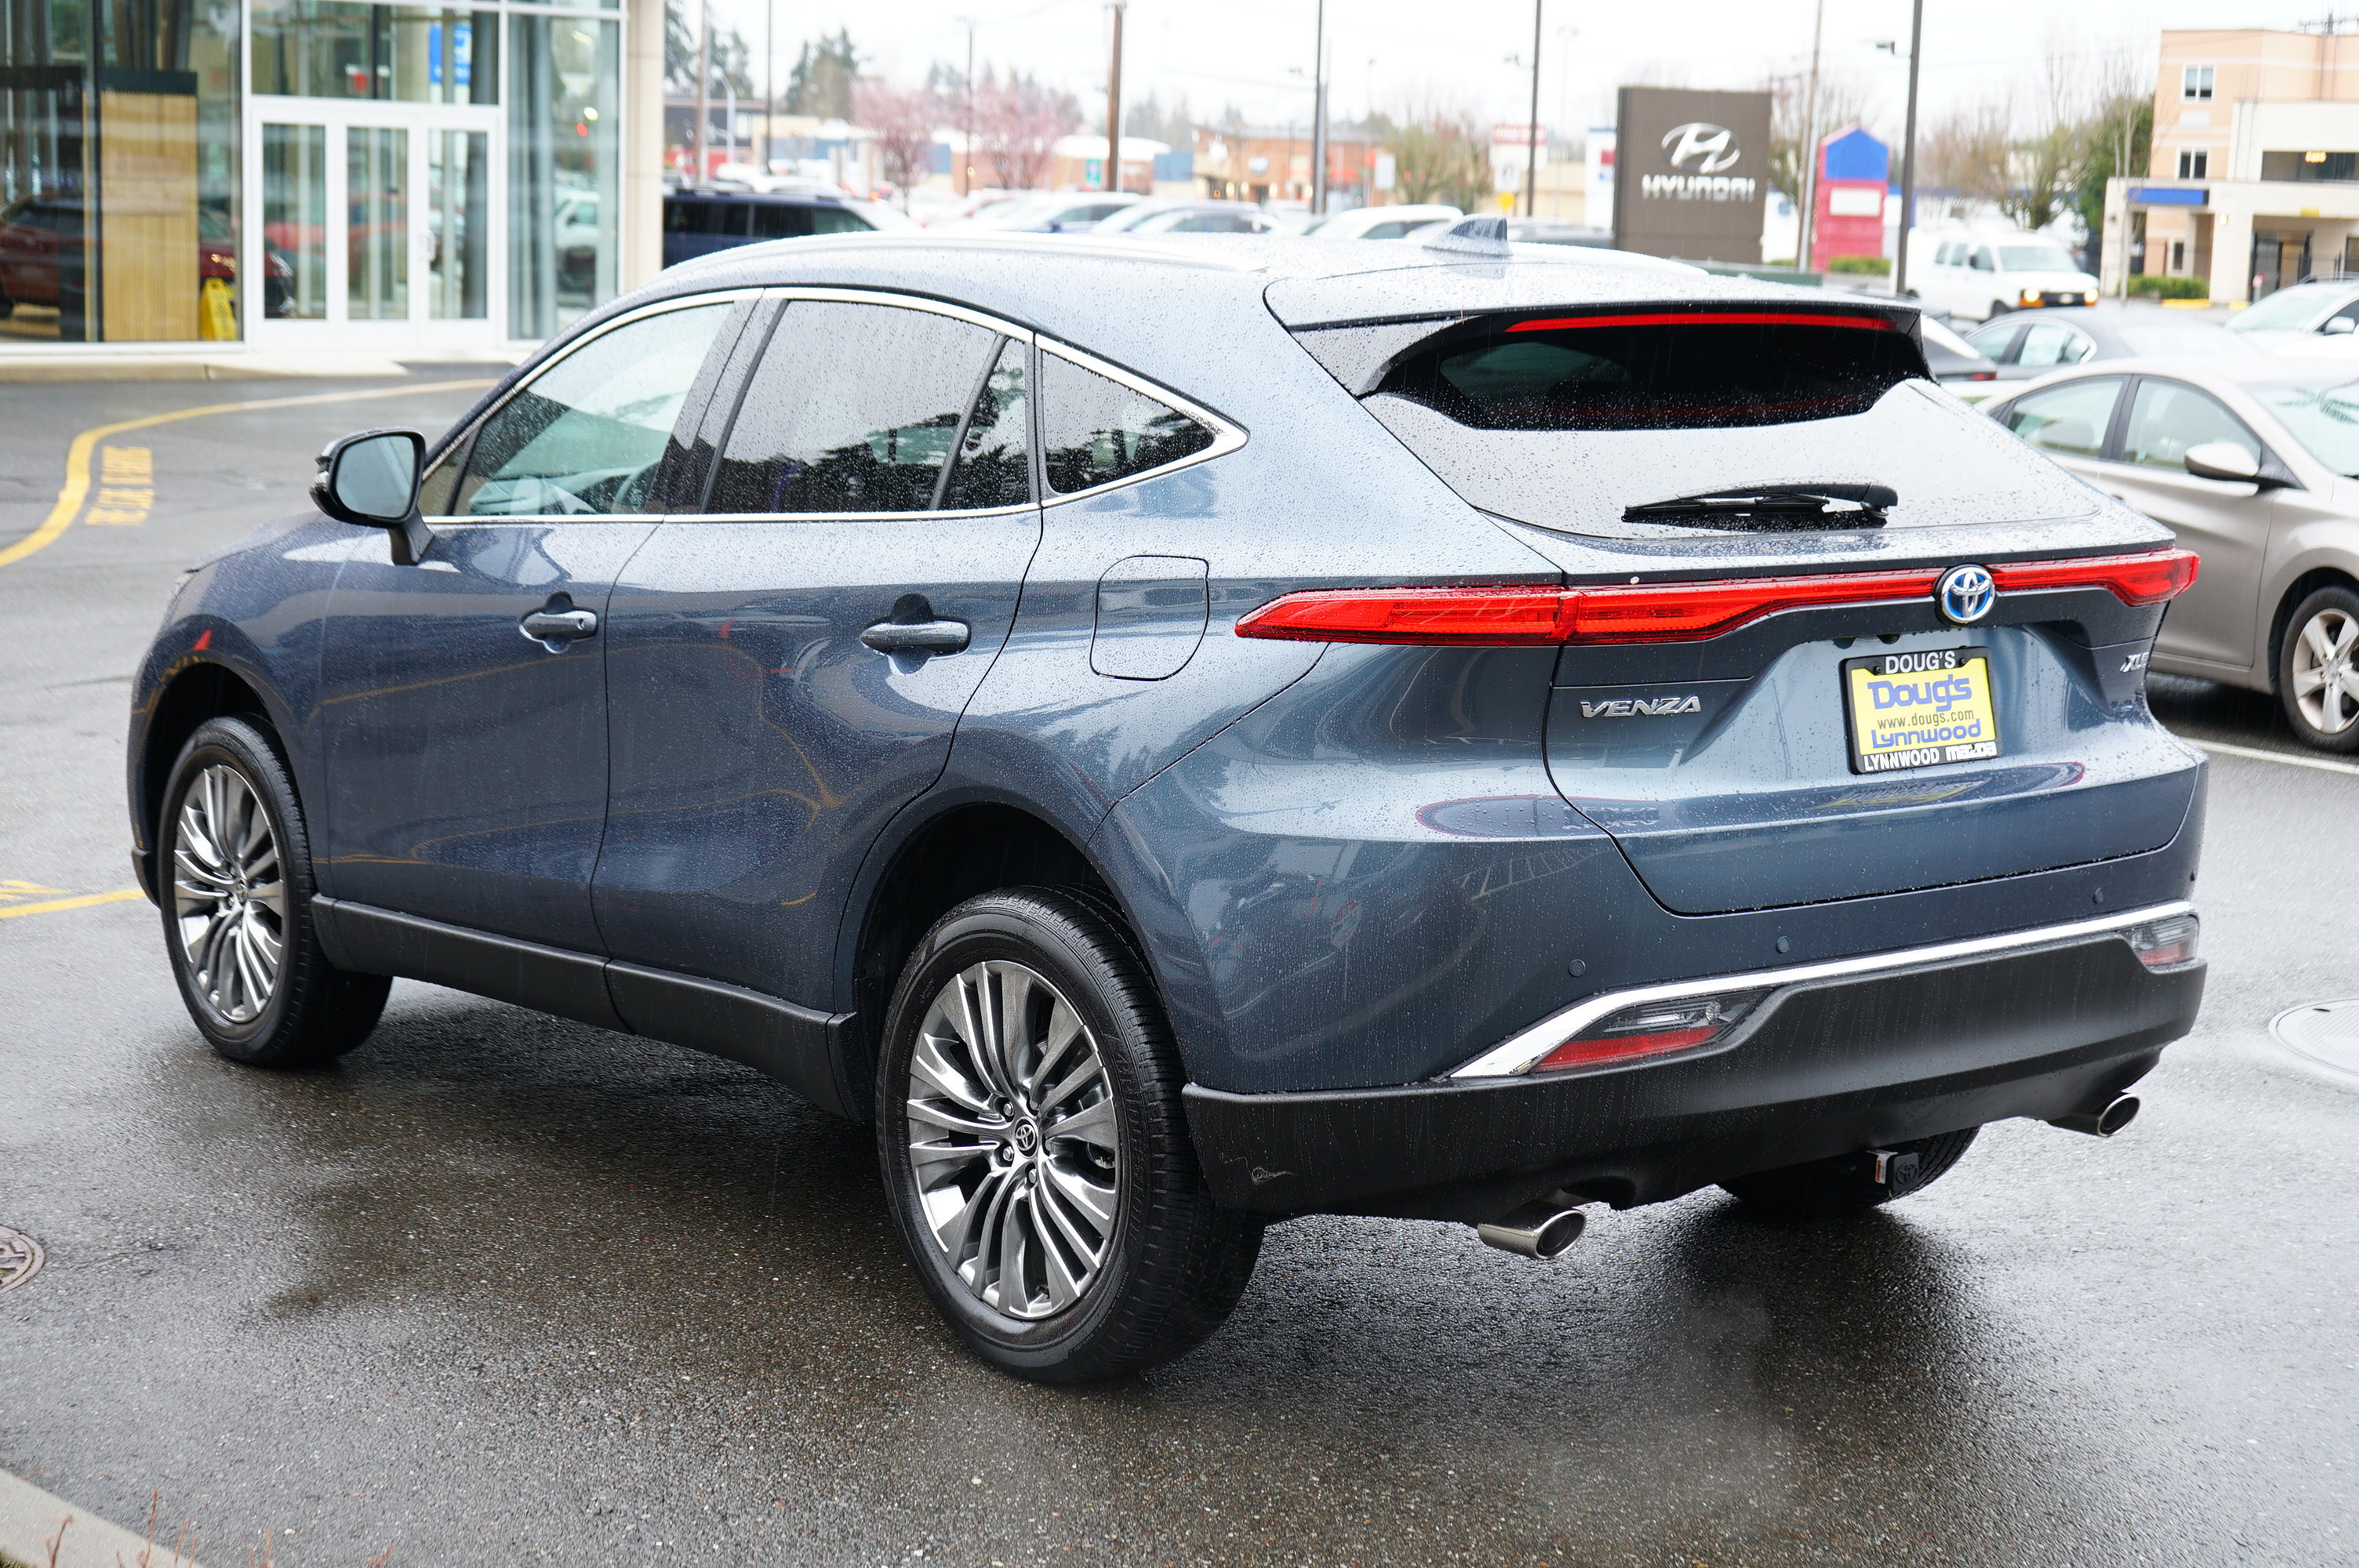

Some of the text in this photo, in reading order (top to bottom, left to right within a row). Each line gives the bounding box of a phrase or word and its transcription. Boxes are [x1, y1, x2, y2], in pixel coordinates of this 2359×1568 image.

[1641, 174, 1756, 201] HYUNDAI
[1886, 651, 1956, 674] DOUG'S
[1579, 696, 1702, 718] VENZA
[1877, 710, 1974, 729] www.dougs.com
[1871, 719, 1981, 748] Lynnwood
[1863, 747, 1939, 771] LYNNWOOD
